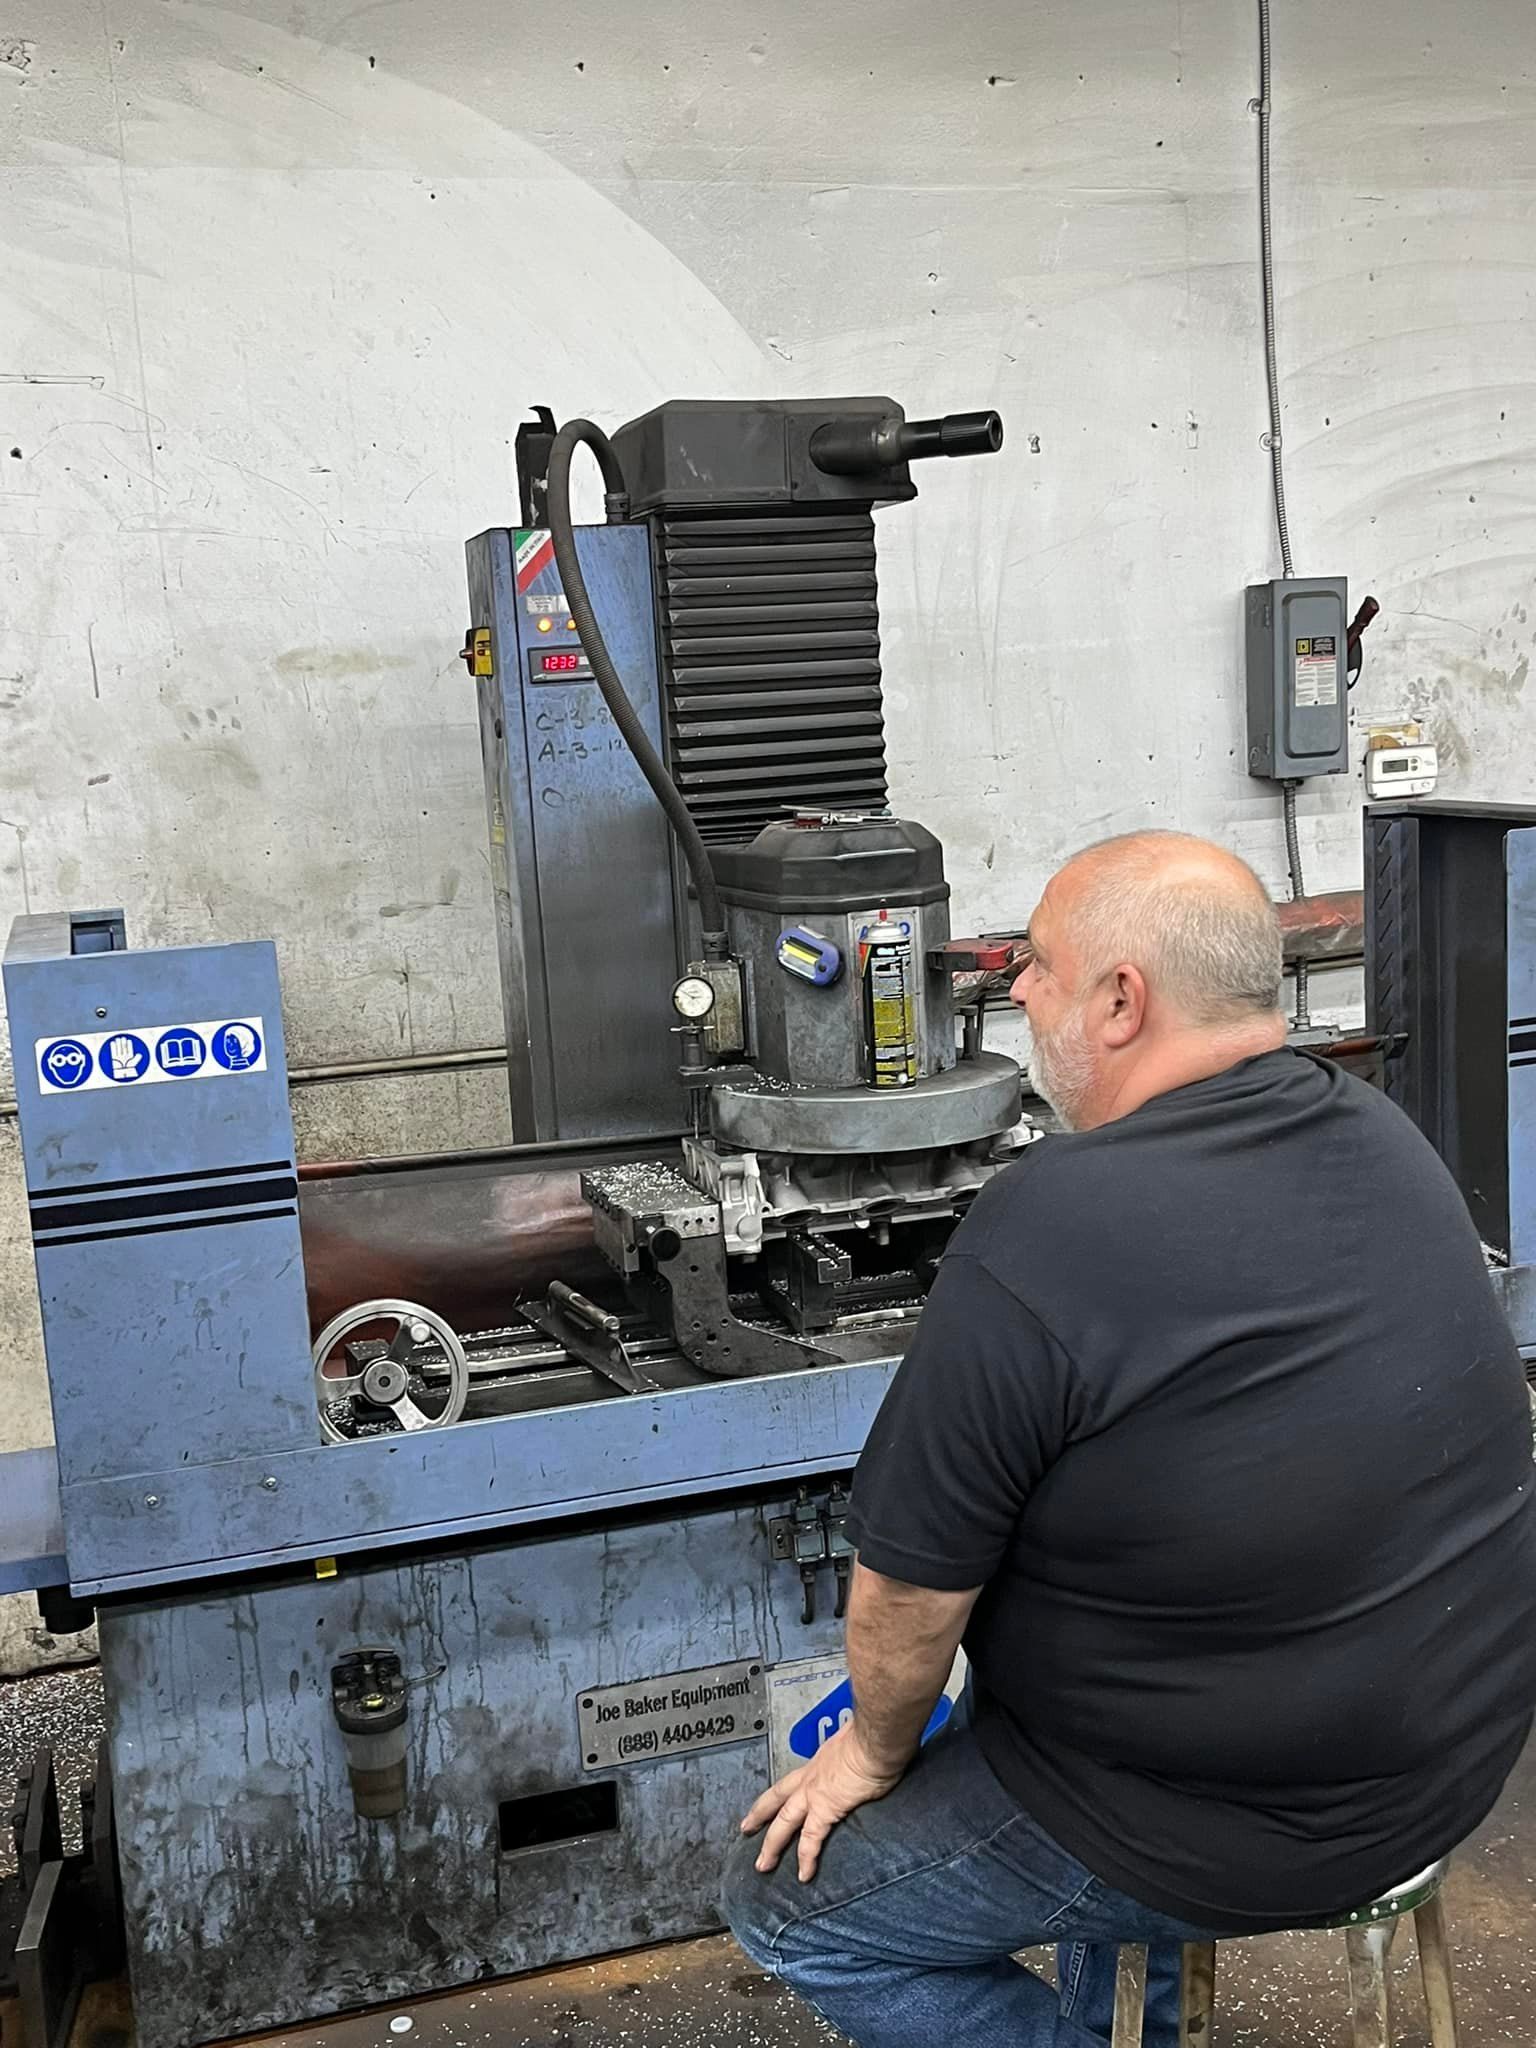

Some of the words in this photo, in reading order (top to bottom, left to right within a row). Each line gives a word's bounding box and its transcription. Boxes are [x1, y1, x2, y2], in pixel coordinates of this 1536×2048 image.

[545, 655, 576, 670] 1232
[595, 1704, 620, 1724] Joe
[624, 1695, 668, 1718] Baker
[672, 1677, 751, 1710] Equipment
[618, 1729, 659, 1759] (888)
[662, 1714, 735, 1745] 440-9429
